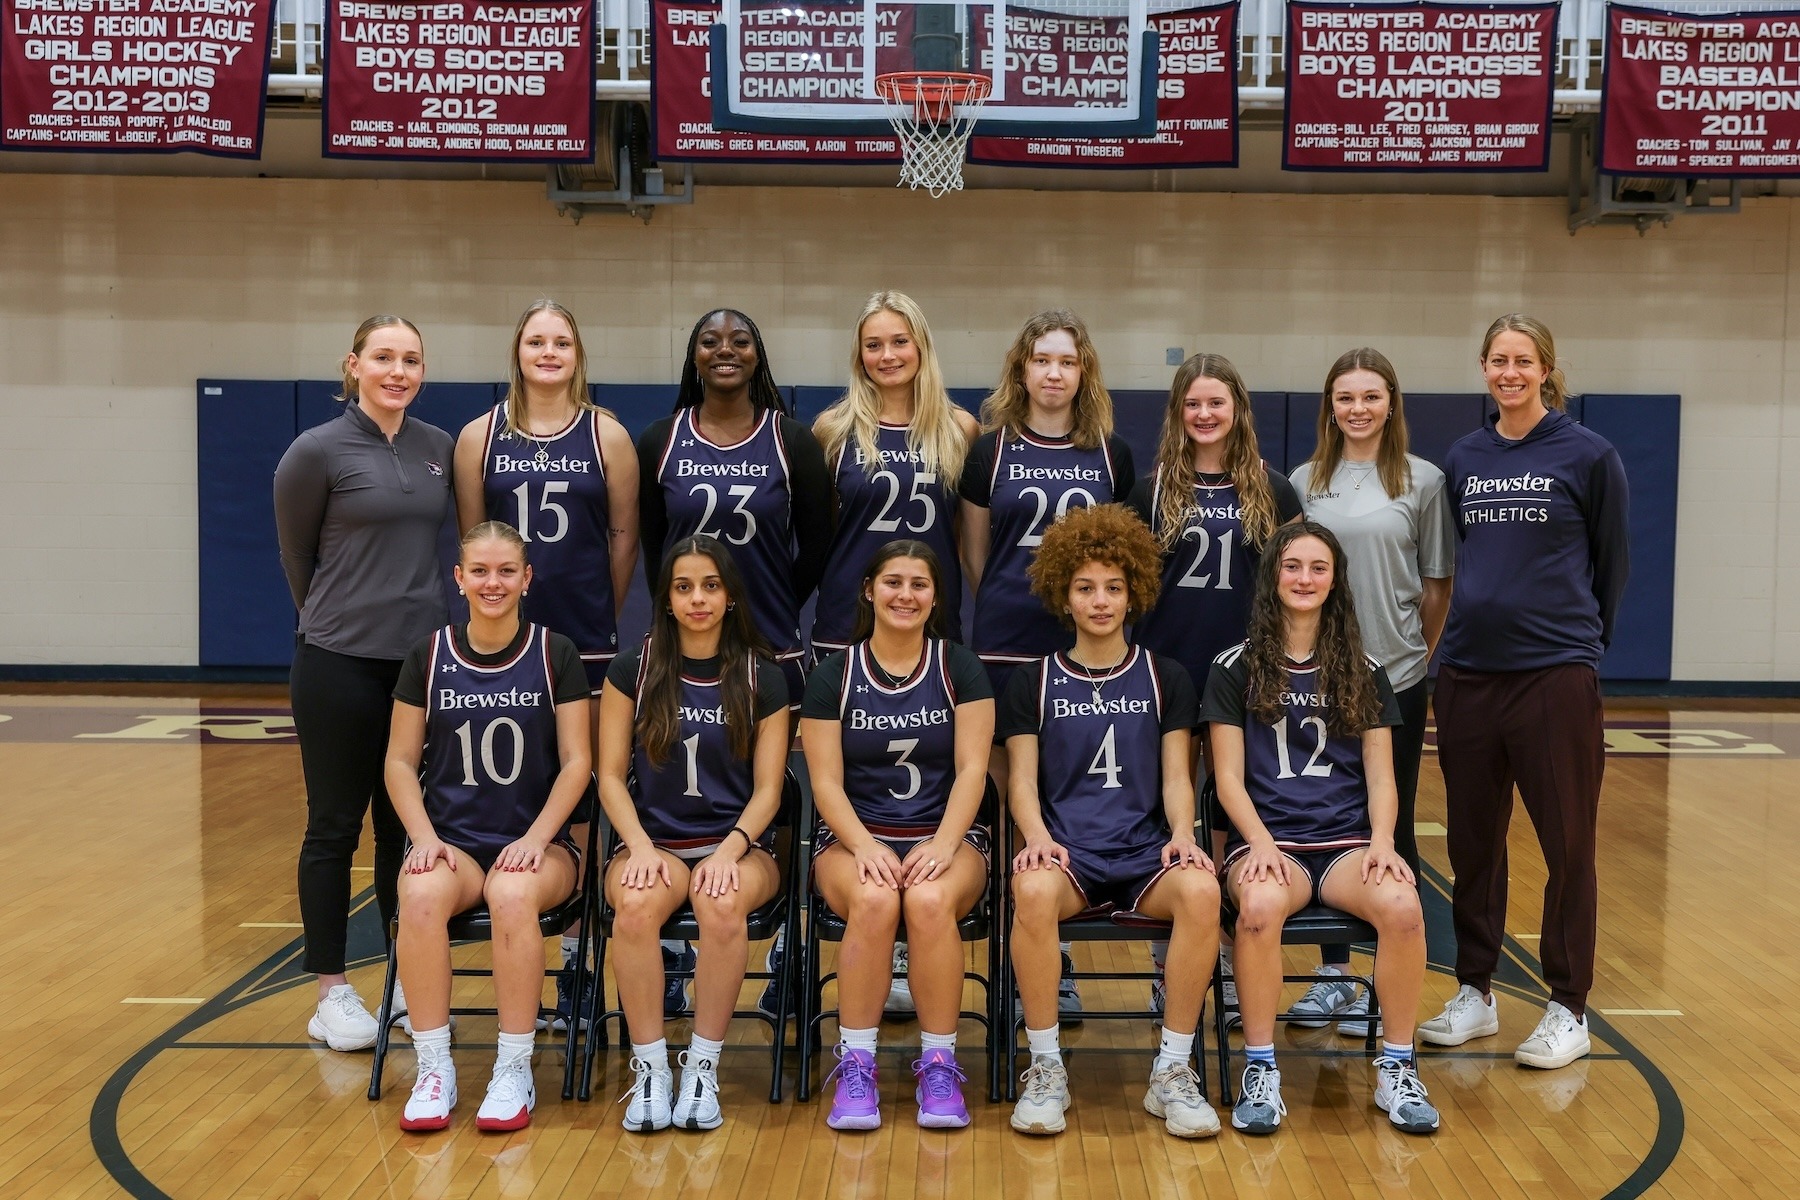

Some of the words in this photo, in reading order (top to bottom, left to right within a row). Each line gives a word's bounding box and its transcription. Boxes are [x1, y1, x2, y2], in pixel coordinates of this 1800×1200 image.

[150, 0, 256, 17] ACADEMY
[339, 2, 464, 21] BREWSTER
[473, 5, 583, 24] ACADEMY
[15, 13, 84, 36] LAKES
[94, 15, 167, 37] REGION
[177, 16, 255, 43] LEAGUE
[1302, 12, 1425, 28] BREWSTER
[1434, 13, 1540, 30] ACADEMY
[1620, 18, 1745, 39] BREWSTER
[340, 21, 410, 45] LAKES
[418, 23, 491, 47] REGION
[501, 26, 581, 48] LEAGUE
[672, 29, 710, 46] LAK
[744, 30, 813, 47] REGION
[1158, 34, 1218, 52] EAGUE
[1302, 31, 1369, 52] LAKES
[1379, 32, 1451, 53] REGION
[1462, 32, 1542, 53] LEAGUE
[24, 39, 112, 61] GIRLS
[123, 40, 241, 66] HOCKEY
[355, 47, 435, 69] BOYS
[445, 50, 565, 72] SOCCER
[1622, 38, 1688, 62] LAKES
[1699, 42, 1773, 63] REGION
[1299, 54, 1376, 76] BOYS
[1388, 55, 1543, 76] LACROSSE
[49, 64, 216, 89] CHAMPIONS
[373, 72, 546, 96] CHAMPIONS
[1336, 78, 1501, 99] CHAMPIONS
[421, 98, 498, 120] 2012
[1384, 101, 1449, 123] 2011
[29, 114, 122, 128] COACHES-ELLISSA
[127, 115, 168, 130] POPOFF,
[350, 119, 394, 133] COACHES
[407, 121, 433, 134] KARL
[436, 122, 482, 136] EDMONDS,
[486, 123, 530, 135] BRENDAN
[533, 124, 567, 136] AUCOIN
[1157, 119, 1181, 131] MATT
[1184, 118, 1228, 130] FONTAINE
[1295, 123, 1365, 135] COACHES-BILL
[1370, 123, 1392, 137] LEE,
[1396, 123, 1421, 135] FRED
[1425, 123, 1471, 137] GARNSEY,
[1474, 123, 1502, 135] BRIAN
[1505, 123, 1540, 136] GIROUX
[1700, 115, 1768, 136] 2011
[6, 128, 111, 143] CAPTAINS-CATHERINE
[212, 134, 253, 150] PORLIER
[407, 136, 441, 150] GOMER,
[444, 138, 481, 150] ANDREW
[484, 138, 513, 152] HOOD,
[515, 139, 554, 151] CHARLIE
[557, 139, 586, 151] KELLY
[676, 138, 724, 150] CAPTAINS:
[729, 139, 753, 151] GREG
[756, 139, 810, 153] MELANSON,
[815, 140, 846, 152] AARON
[855, 140, 895, 153] TITCOMB
[1383, 136, 1426, 150] BILLINGS,
[1430, 137, 1472, 149] JACKSON
[1476, 137, 1526, 149] CALLAHAN
[1715, 139, 1765, 152] SULLIVAN,
[1772, 139, 1791, 150] JAY
[1027, 143, 1072, 156] BRANDON
[1075, 145, 1124, 158] TONSBERG
[1343, 151, 1372, 163] MITCH
[1376, 151, 1423, 164] CHAPMAN,
[1428, 151, 1460, 162] JAMES
[1464, 151, 1504, 163] MURPHY
[493, 454, 590, 473] Brewster
[676, 459, 769, 477] Brewster
[1008, 463, 1101, 482] Brewster
[1464, 471, 1554, 497] Brewster
[512, 481, 569, 543] 15
[867, 470, 937, 533] 25
[689, 483, 757, 546] 23
[1464, 507, 1548, 525] ATHLETICS
[1177, 526, 1233, 590] 21
[439, 686, 542, 711] Brewster
[1052, 695, 1150, 719] Brewster
[850, 705, 949, 730] Brewster
[455, 716, 525, 786] 10
[1087, 723, 1123, 788] 4
[1271, 716, 1334, 779] 12
[683, 733, 703, 797] 1
[886, 738, 922, 800] 3
